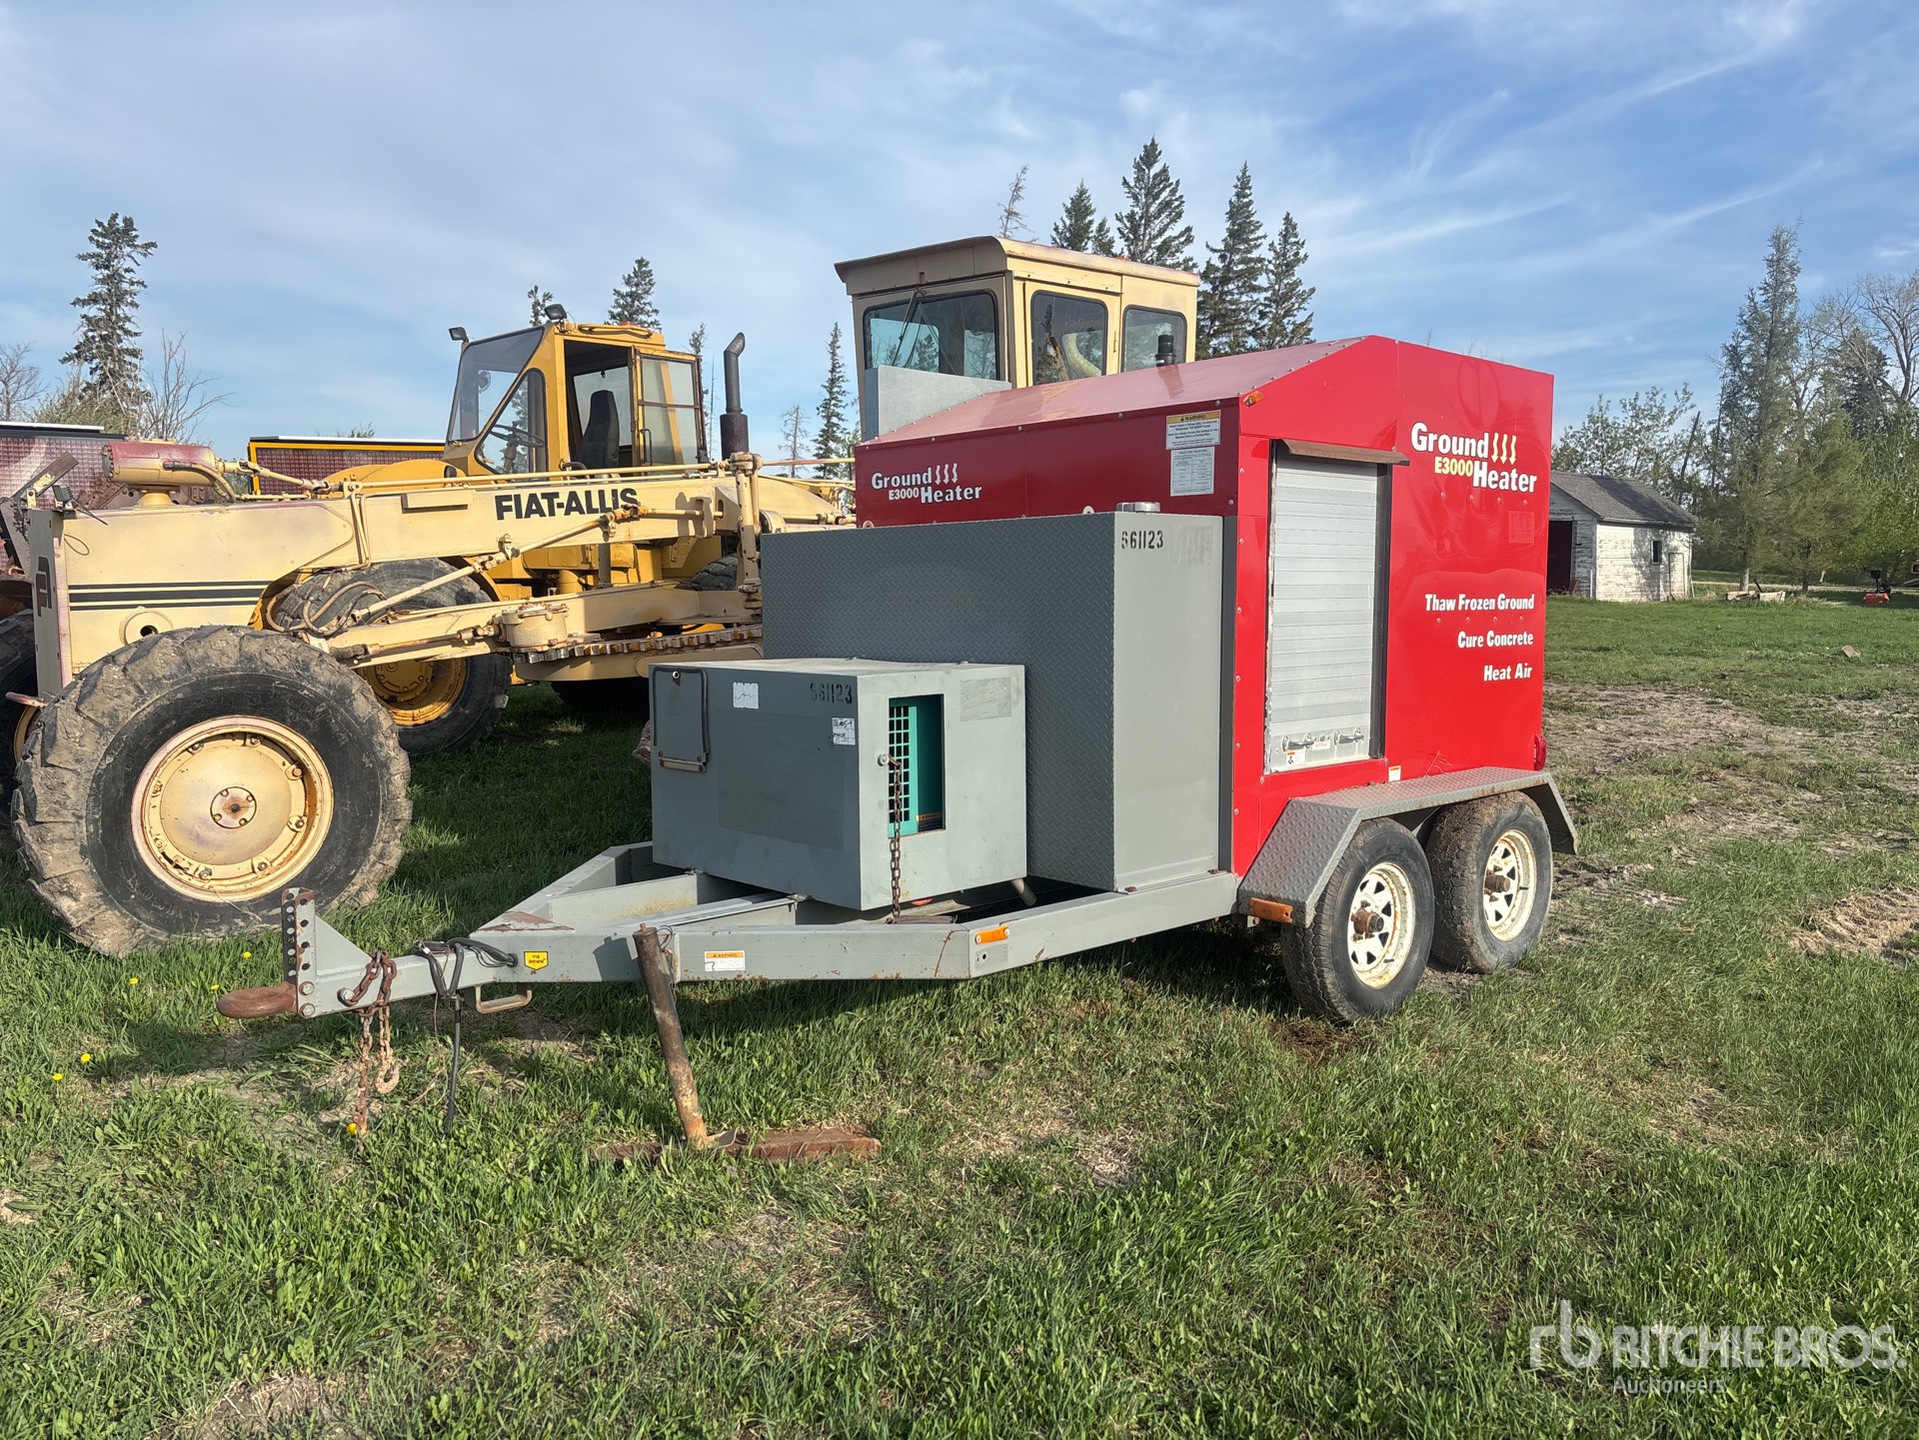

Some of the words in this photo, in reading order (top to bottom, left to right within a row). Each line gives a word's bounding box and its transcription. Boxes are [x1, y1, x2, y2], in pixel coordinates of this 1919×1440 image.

[1411, 421, 1489, 459] Ground
[1434, 456, 1473, 477] E3000
[1472, 460, 1538, 493] Heater
[871, 466, 932, 489] Ground
[494, 487, 640, 521] FIAT-ALLIS
[888, 487, 920, 501] E3000
[920, 485, 982, 504] Heater
[1424, 593, 1457, 611] Thaw
[1458, 593, 1496, 611] Frozen
[1497, 593, 1535, 610] Ground
[1457, 630, 1484, 648] Cure
[1486, 630, 1534, 647] Concrete
[1483, 664, 1512, 682] Heat
[1514, 662, 1533, 679] Air
